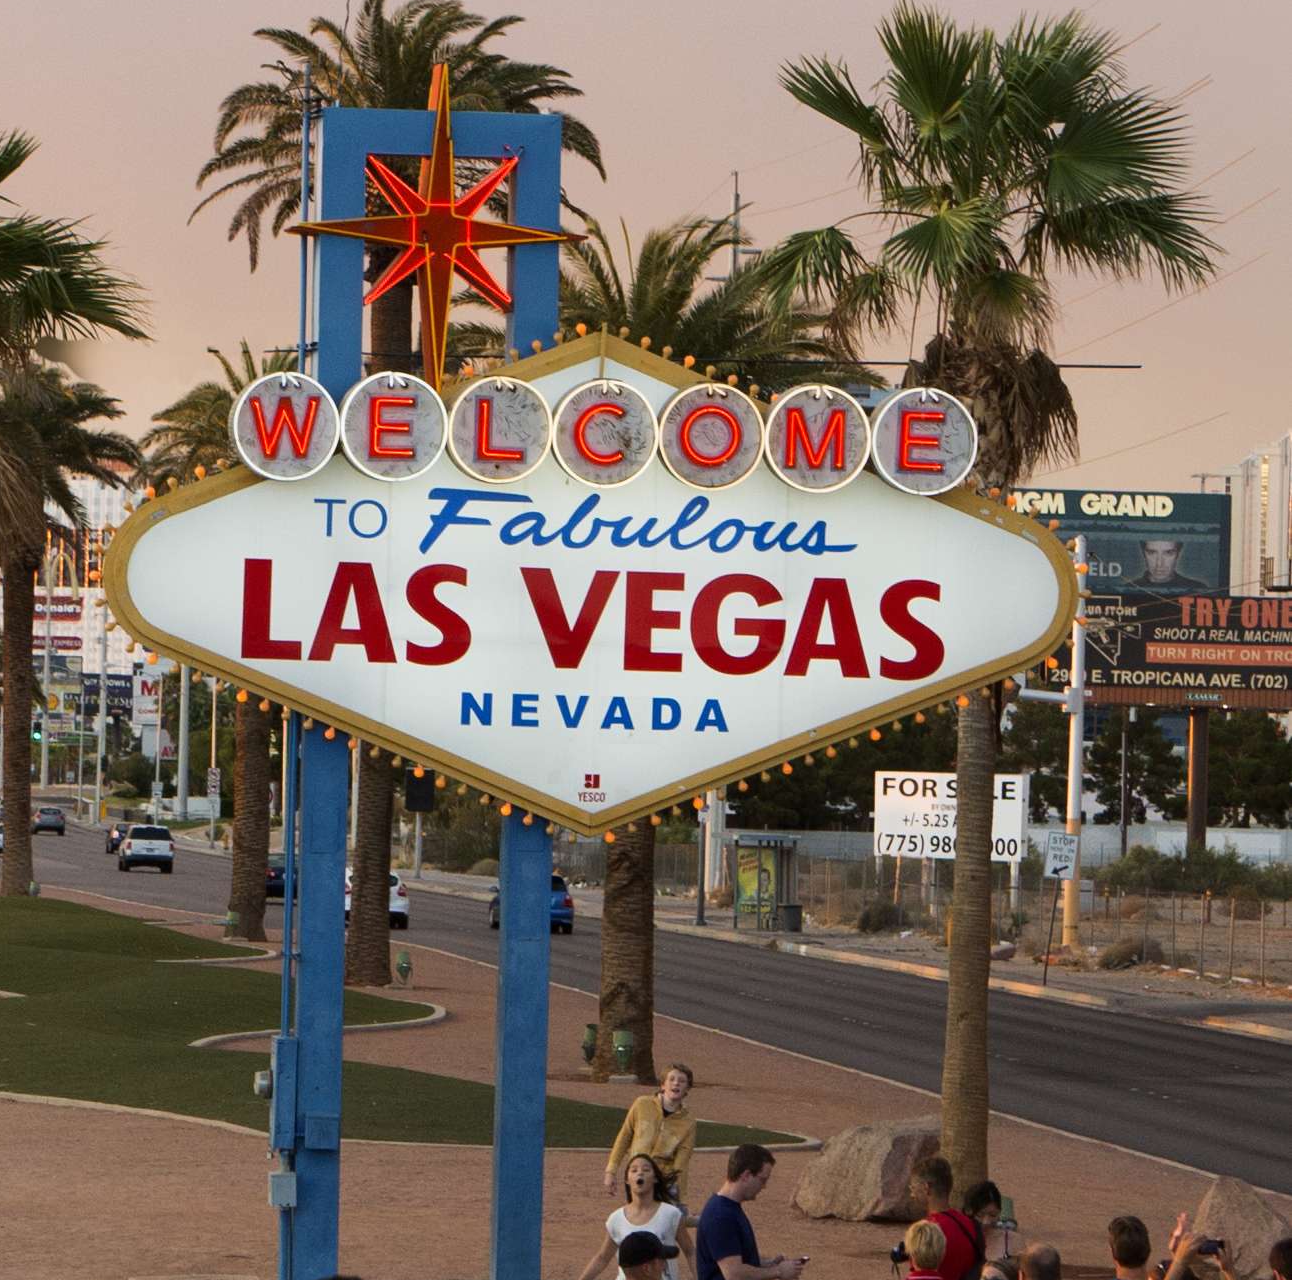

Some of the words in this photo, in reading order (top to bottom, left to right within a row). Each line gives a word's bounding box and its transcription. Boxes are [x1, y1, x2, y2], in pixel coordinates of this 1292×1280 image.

[249, 393, 947, 476] WELCOME
[1080, 493, 1174, 517] GRAND
[314, 498, 388, 538] TO
[419, 487, 858, 556] Fabulous
[1088, 561, 1122, 578] ELD
[34, 603, 82, 613] Donald's
[1178, 596, 1233, 627] TRY
[1241, 599, 1292, 629] ONE
[241, 558, 472, 666] LAS
[520, 567, 945, 681] VEGAS
[1154, 627, 1196, 640] SHOOT
[1198, 630, 1206, 640] A
[1209, 630, 1240, 642] REAL
[1244, 631, 1292, 643] MACHIN
[1148, 647, 1186, 659] TURN
[1192, 648, 1235, 660] RIGHT
[1240, 650, 1260, 661] ON
[1051, 669, 1087, 682] 29
[1092, 670, 1106, 684] E.
[1112, 670, 1206, 686] TROPICANA
[1209, 673, 1246, 688] AVE.
[1250, 675, 1288, 689] (702)
[460, 691, 729, 732] NEVADA
[578, 792, 606, 803] YESCO
[883, 778, 937, 797] FOR
[946, 780, 1016, 800] SE
[903, 813, 919, 827] +/-
[922, 814, 949, 828] 5.25
[877, 833, 925, 854] (775)
